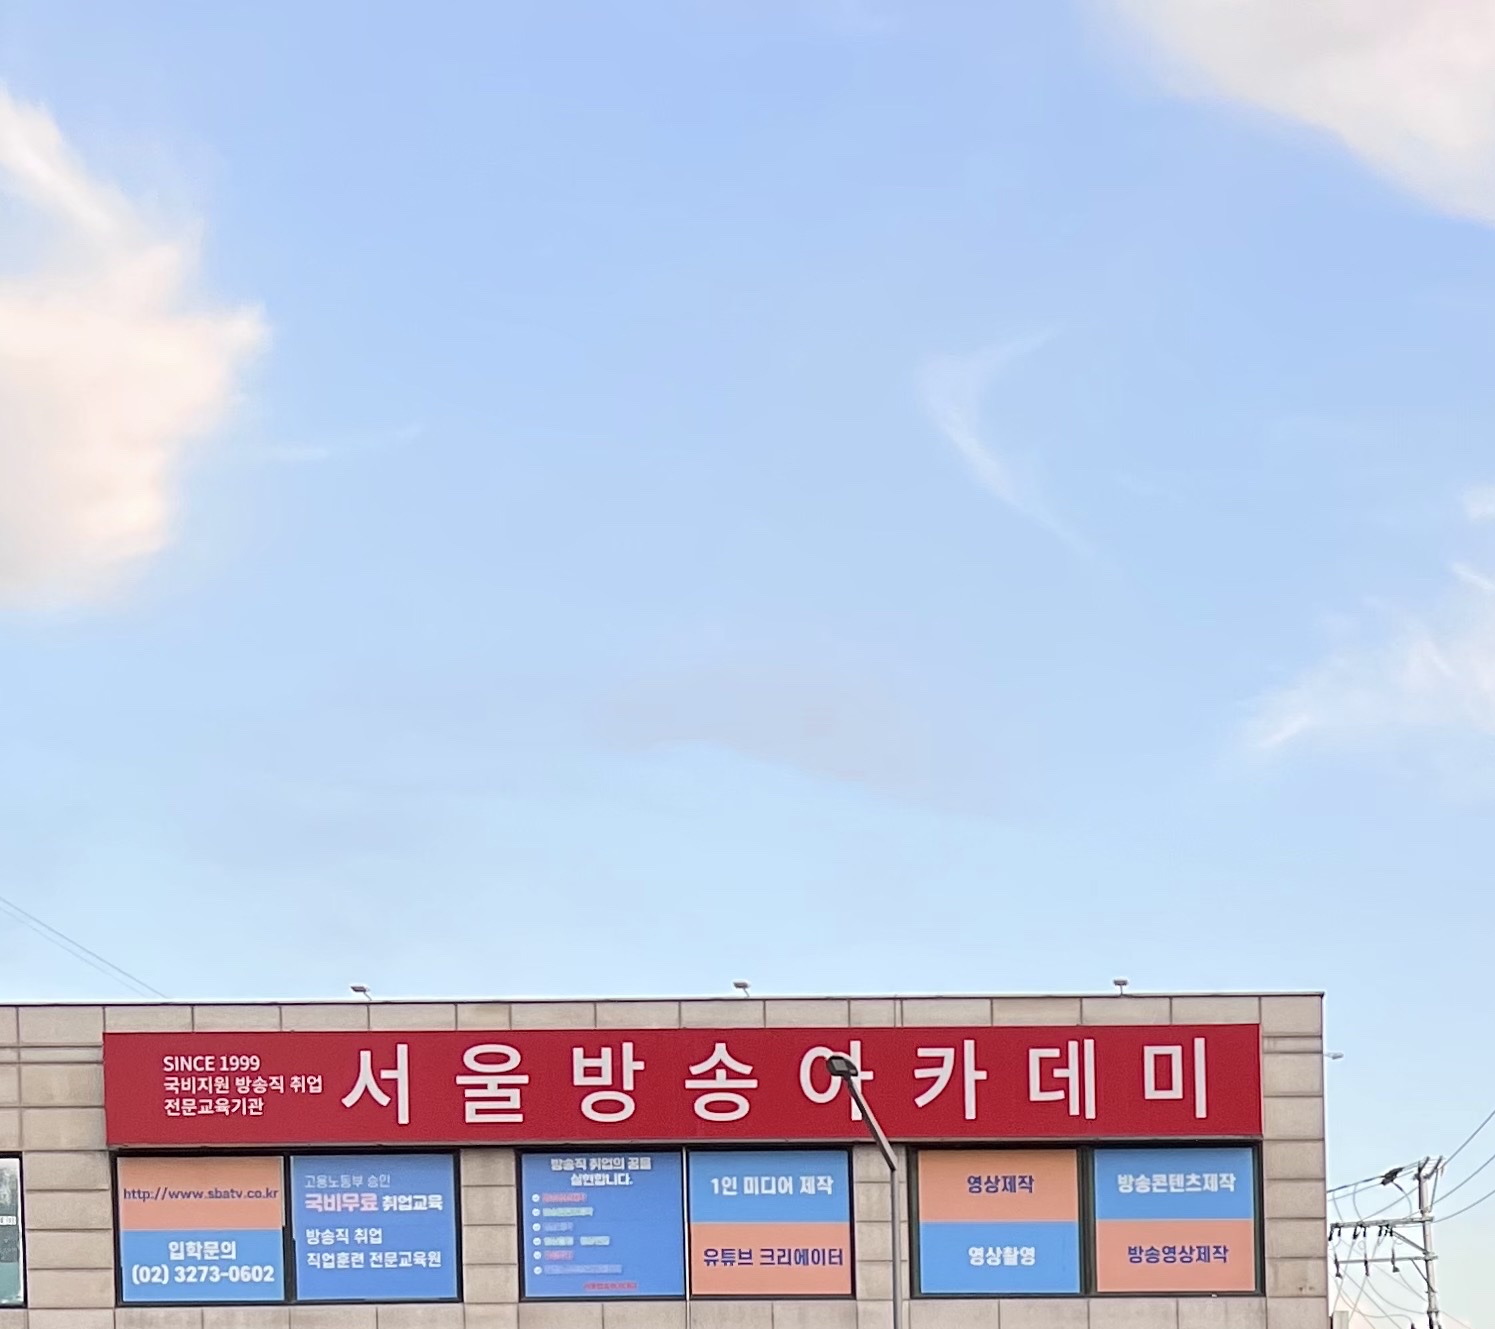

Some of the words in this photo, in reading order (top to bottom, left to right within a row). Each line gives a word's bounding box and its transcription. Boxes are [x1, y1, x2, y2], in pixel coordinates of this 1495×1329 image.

[163, 1056, 215, 1071] SINCE
[219, 1056, 260, 1071] 1999
[163, 1076, 230, 1094] 국비지원
[235, 1076, 284, 1093] 방송직
[290, 1075, 323, 1093] 취업
[164, 1098, 264, 1116] 전문교육기관
[711, 1176, 738, 1196] 1인
[743, 1175, 793, 1195] 미디어
[800, 1175, 834, 1195] 제작
[967, 1175, 1035, 1194] 영상제작
[1117, 1173, 1237, 1194] 방송콘텐츠제작
[305, 1193, 379, 1212] 국비무료
[382, 1194, 443, 1211] 취업교육
[306, 1228, 349, 1245] 방송직
[354, 1228, 382, 1245] 취업
[168, 1241, 236, 1260] 입학문의
[307, 1252, 364, 1269] 직업훈련
[369, 1251, 441, 1268] 전문교육원
[703, 1248, 754, 1267] 유튜브
[759, 1247, 844, 1266] 크리에이터
[968, 1246, 1036, 1267] 영상촬영
[1127, 1245, 1229, 1264] 방송영상제작
[132, 1264, 168, 1284] (02)
[174, 1265, 275, 1283] 3273-0602
